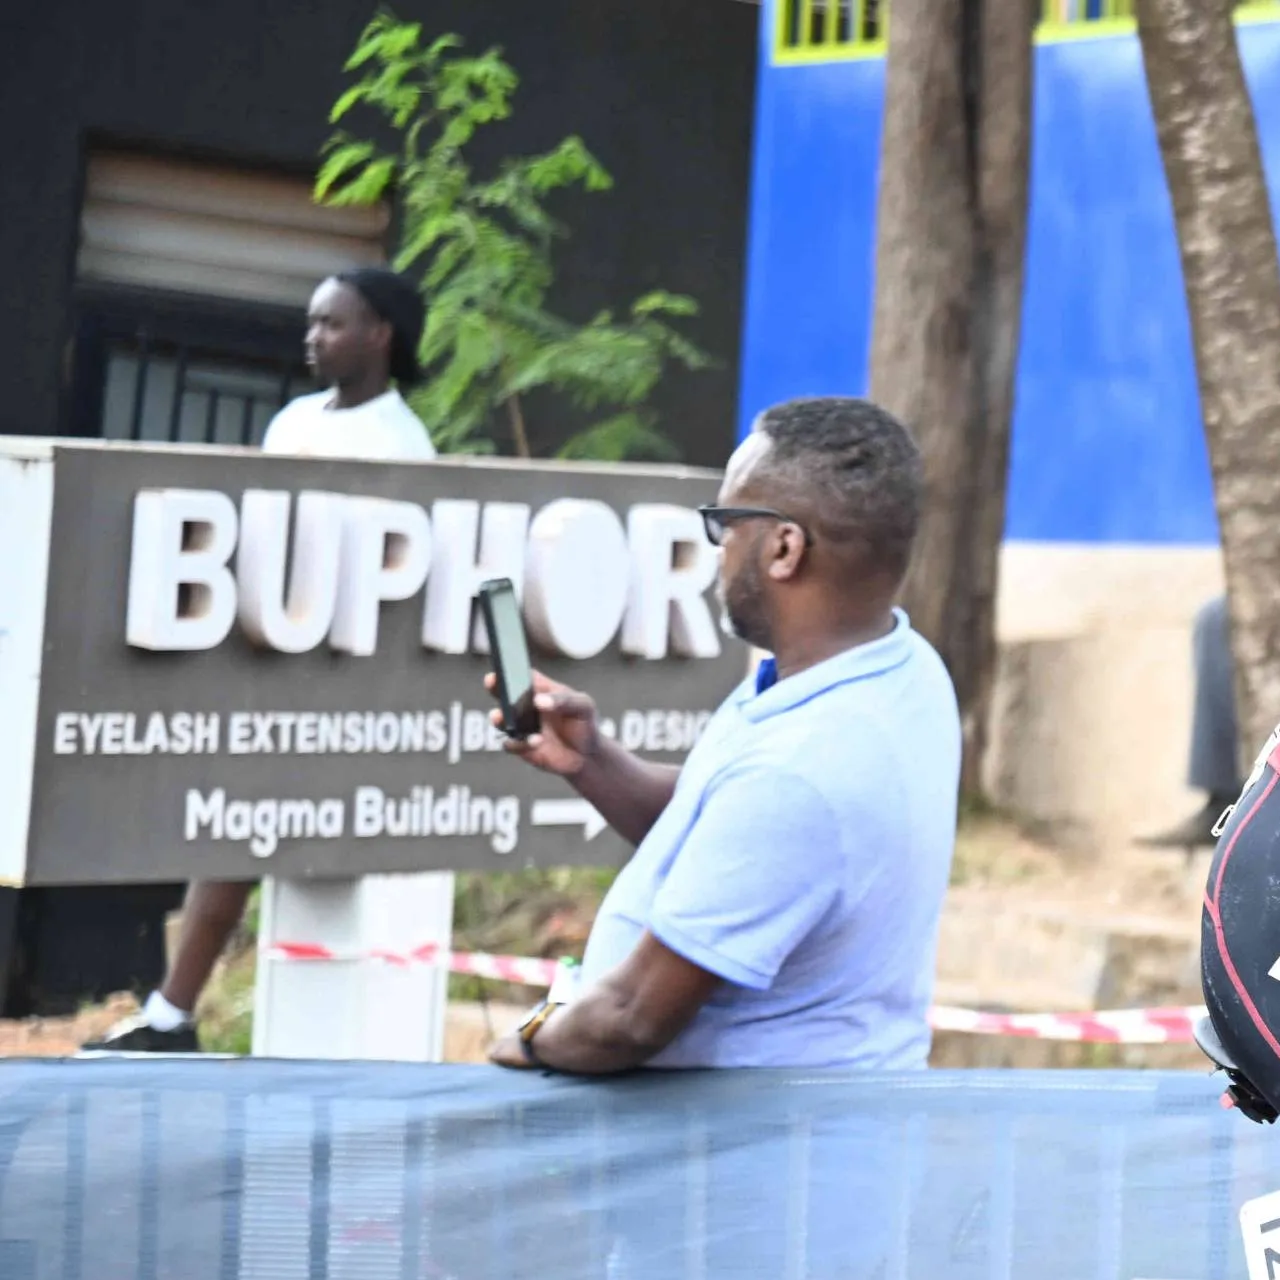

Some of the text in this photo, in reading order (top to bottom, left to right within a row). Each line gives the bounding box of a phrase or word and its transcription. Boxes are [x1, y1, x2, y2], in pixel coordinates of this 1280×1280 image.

[54, 710, 221, 755] EYELASH
[184, 784, 520, 858] Magma Building
